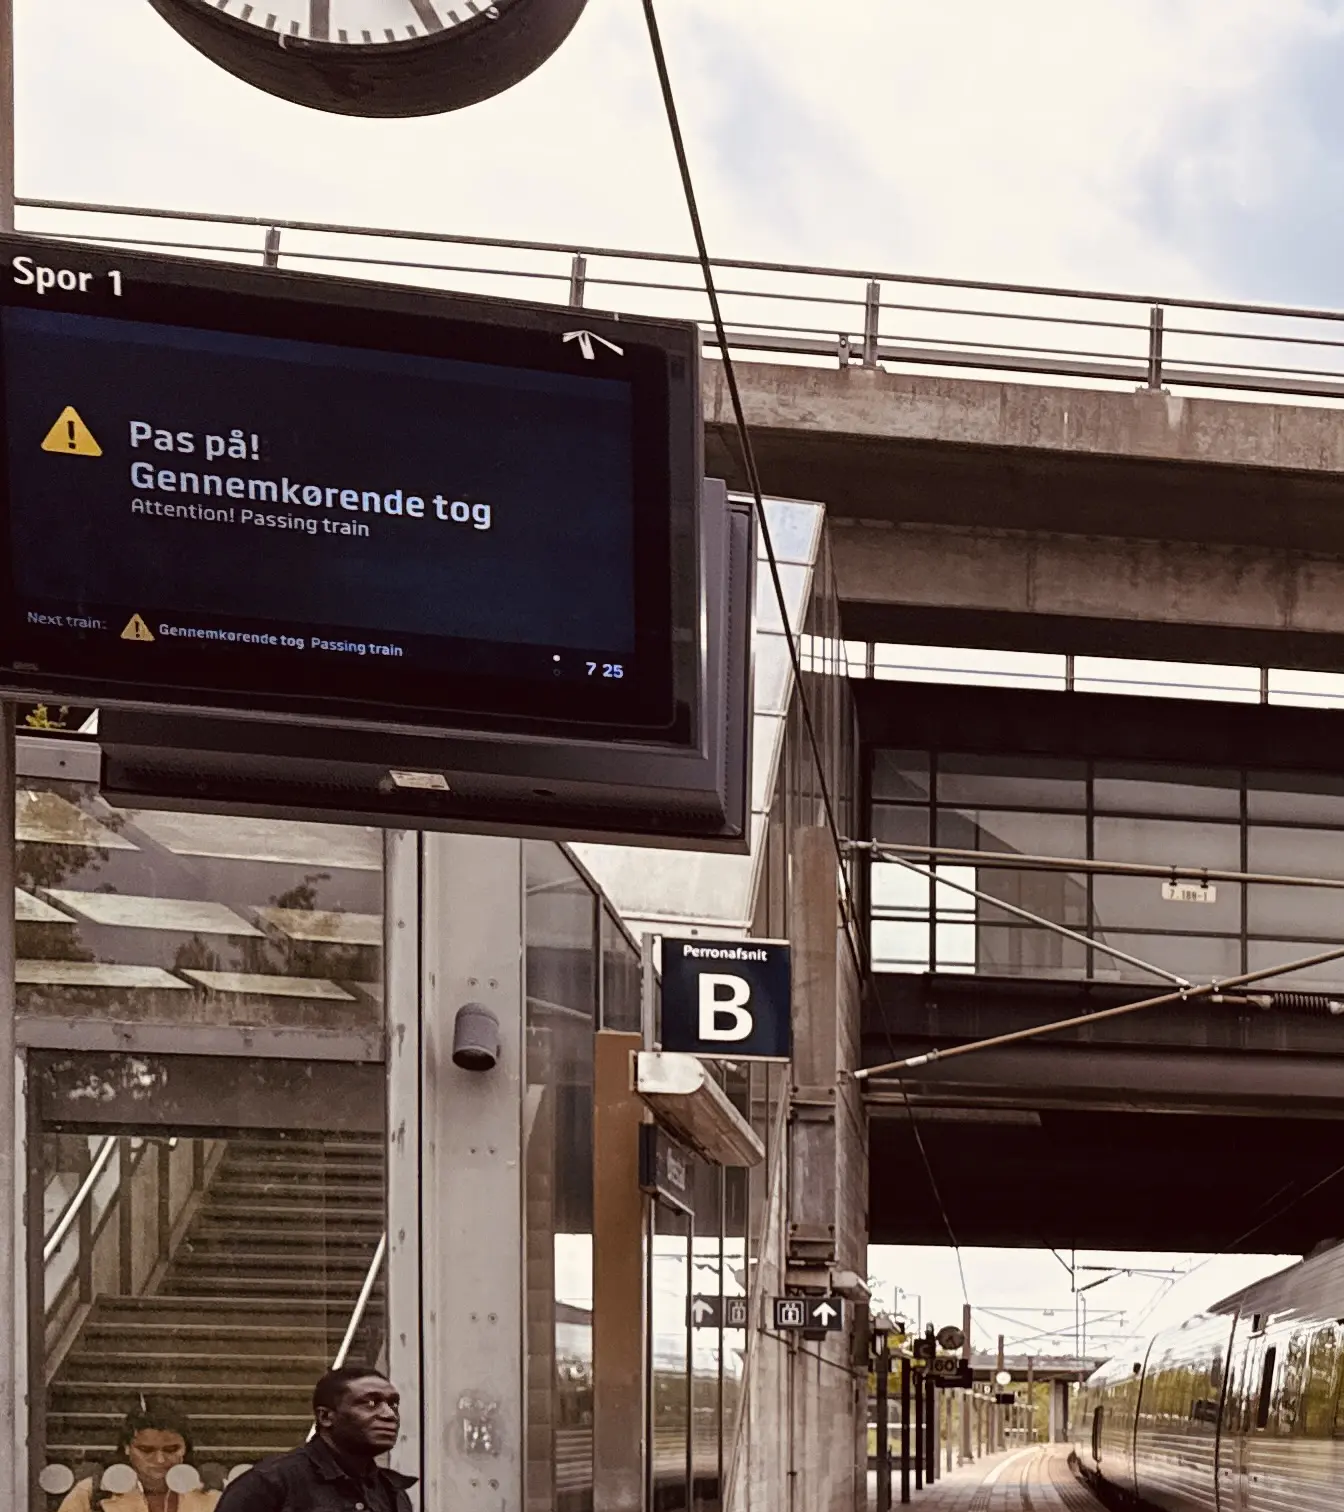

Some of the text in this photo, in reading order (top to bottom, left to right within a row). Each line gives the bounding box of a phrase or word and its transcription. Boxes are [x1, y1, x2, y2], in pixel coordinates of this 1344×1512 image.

[12, 255, 122, 296] Spor 1
[129, 420, 260, 461] Pas på!
[130, 461, 492, 530] Gennemkørende tog
[131, 498, 370, 537] Attention! Passing train
[27, 611, 62, 628] Next
[159, 623, 403, 657] Gennemkørende tog Passing train
[683, 944, 768, 962] Perronafsnit
[698, 972, 753, 1042] B
